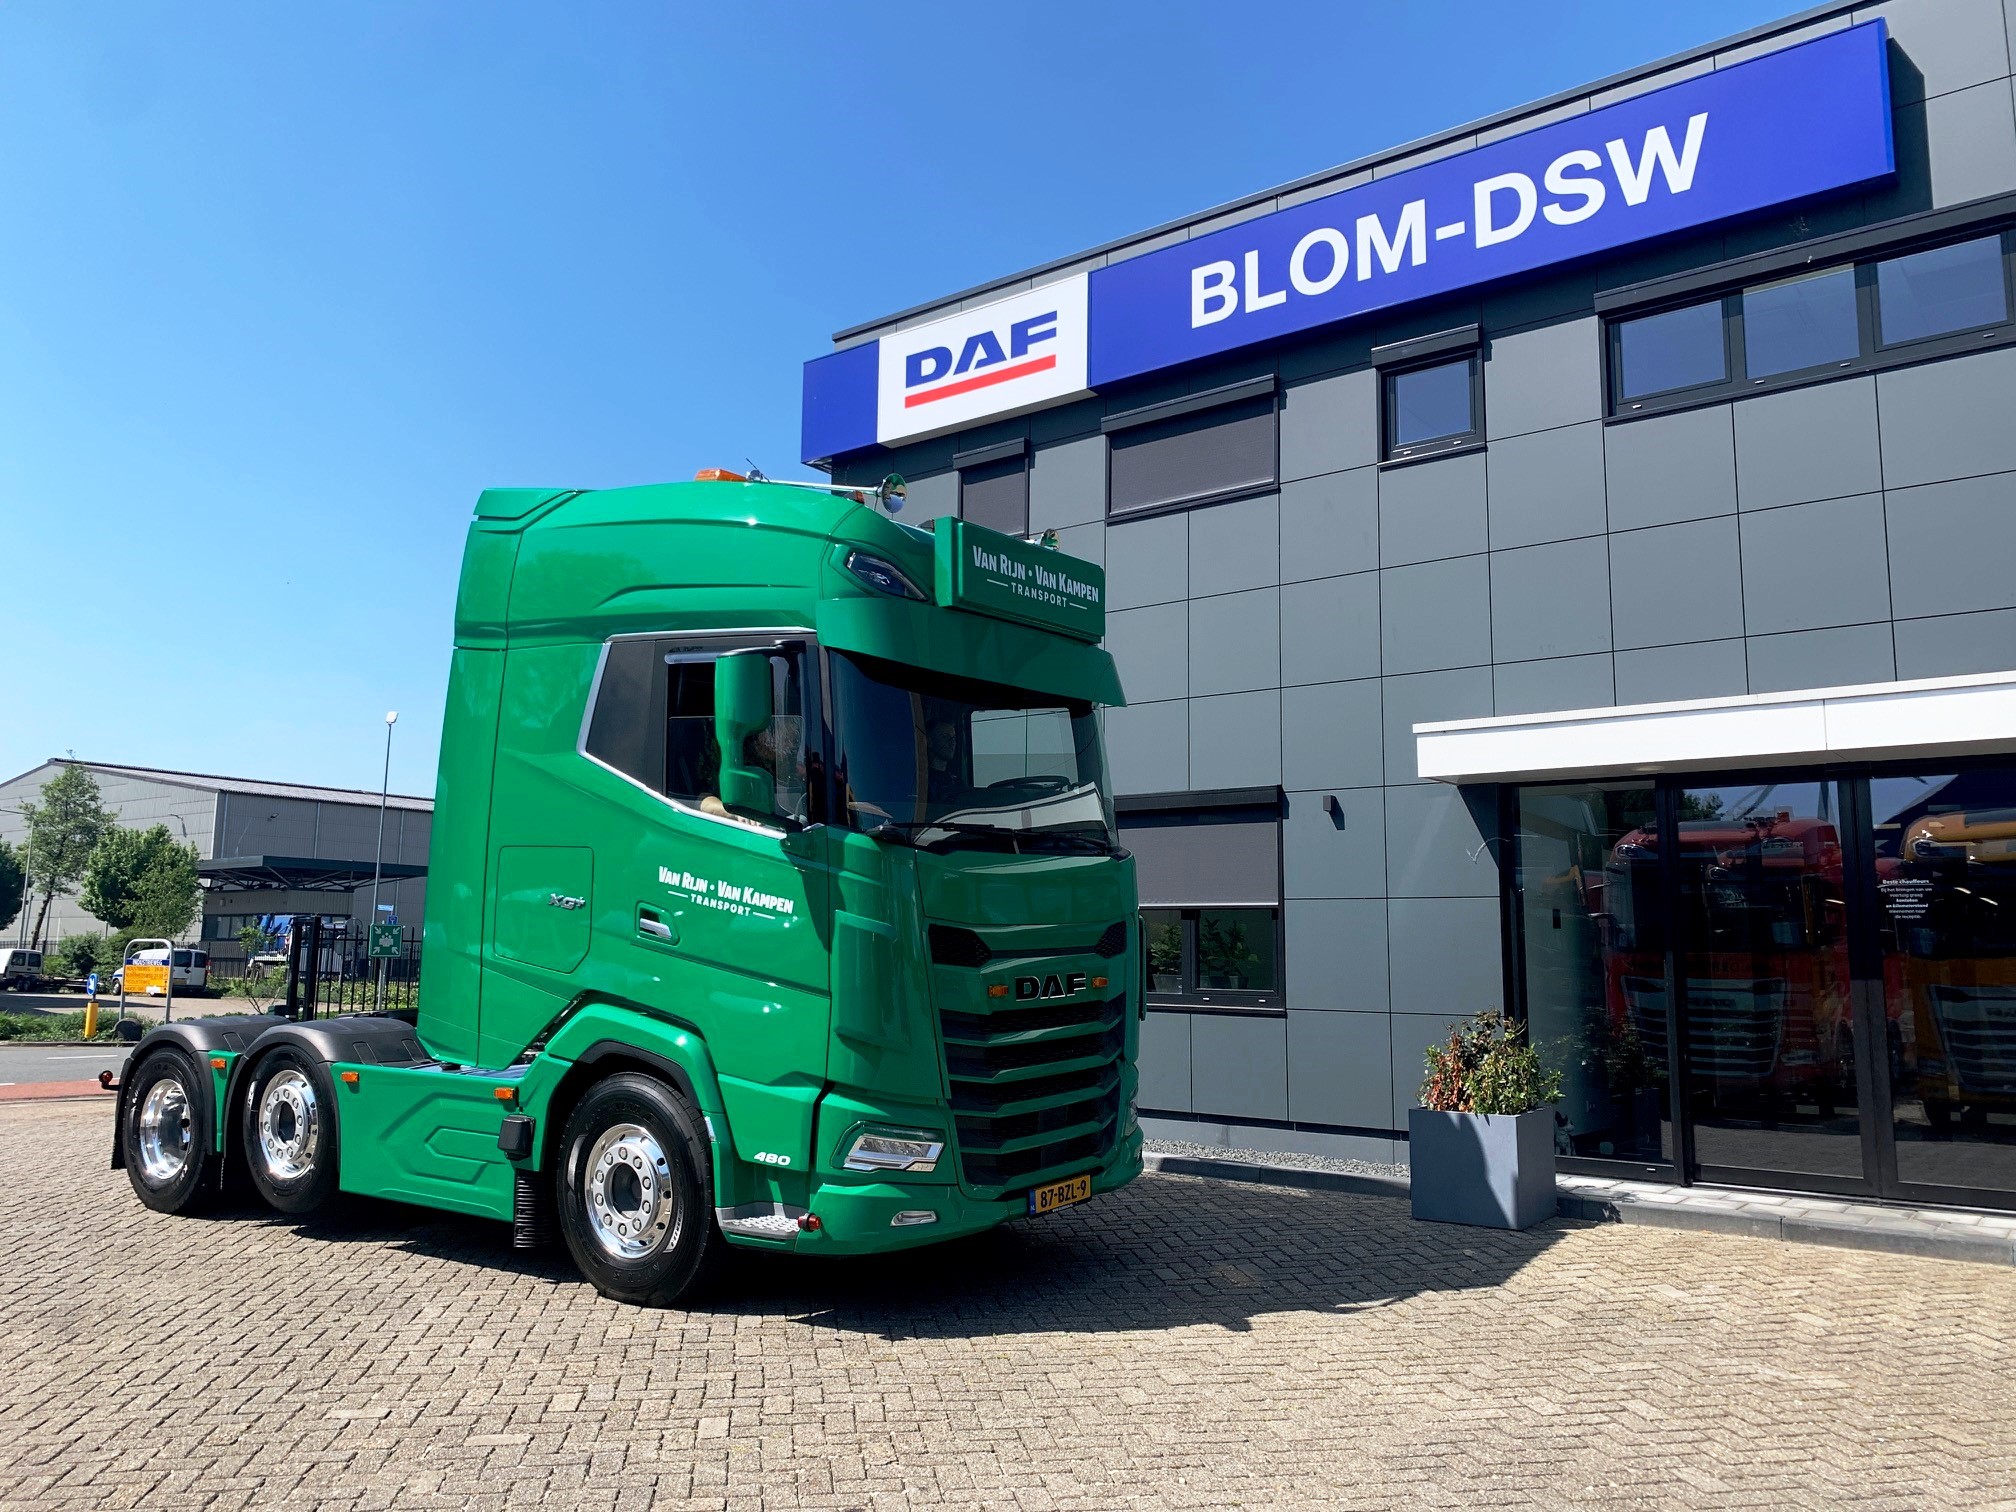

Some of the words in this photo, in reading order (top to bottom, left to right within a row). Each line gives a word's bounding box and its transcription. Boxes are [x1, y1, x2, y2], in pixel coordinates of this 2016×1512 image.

[1191, 112, 1708, 329] BLOM-DSW
[905, 310, 1058, 389] DAF
[972, 544, 998, 573] VAN
[1000, 553, 1026, 581] RIJN
[1034, 564, 1057, 590] VAN
[1058, 572, 1099, 603] KAMPEN
[1011, 582, 1067, 608] TRANSPORT
[659, 865, 681, 887] VAN
[682, 871, 708, 893] RIJN
[717, 880, 742, 902] VAN
[743, 886, 794, 914] KAMPEN
[690, 893, 751, 916] TRANSPORT
[1015, 971, 1087, 1001] DAF
[753, 1151, 791, 1166] 480
[1040, 1179, 1087, 1208] 87-BZL-9
